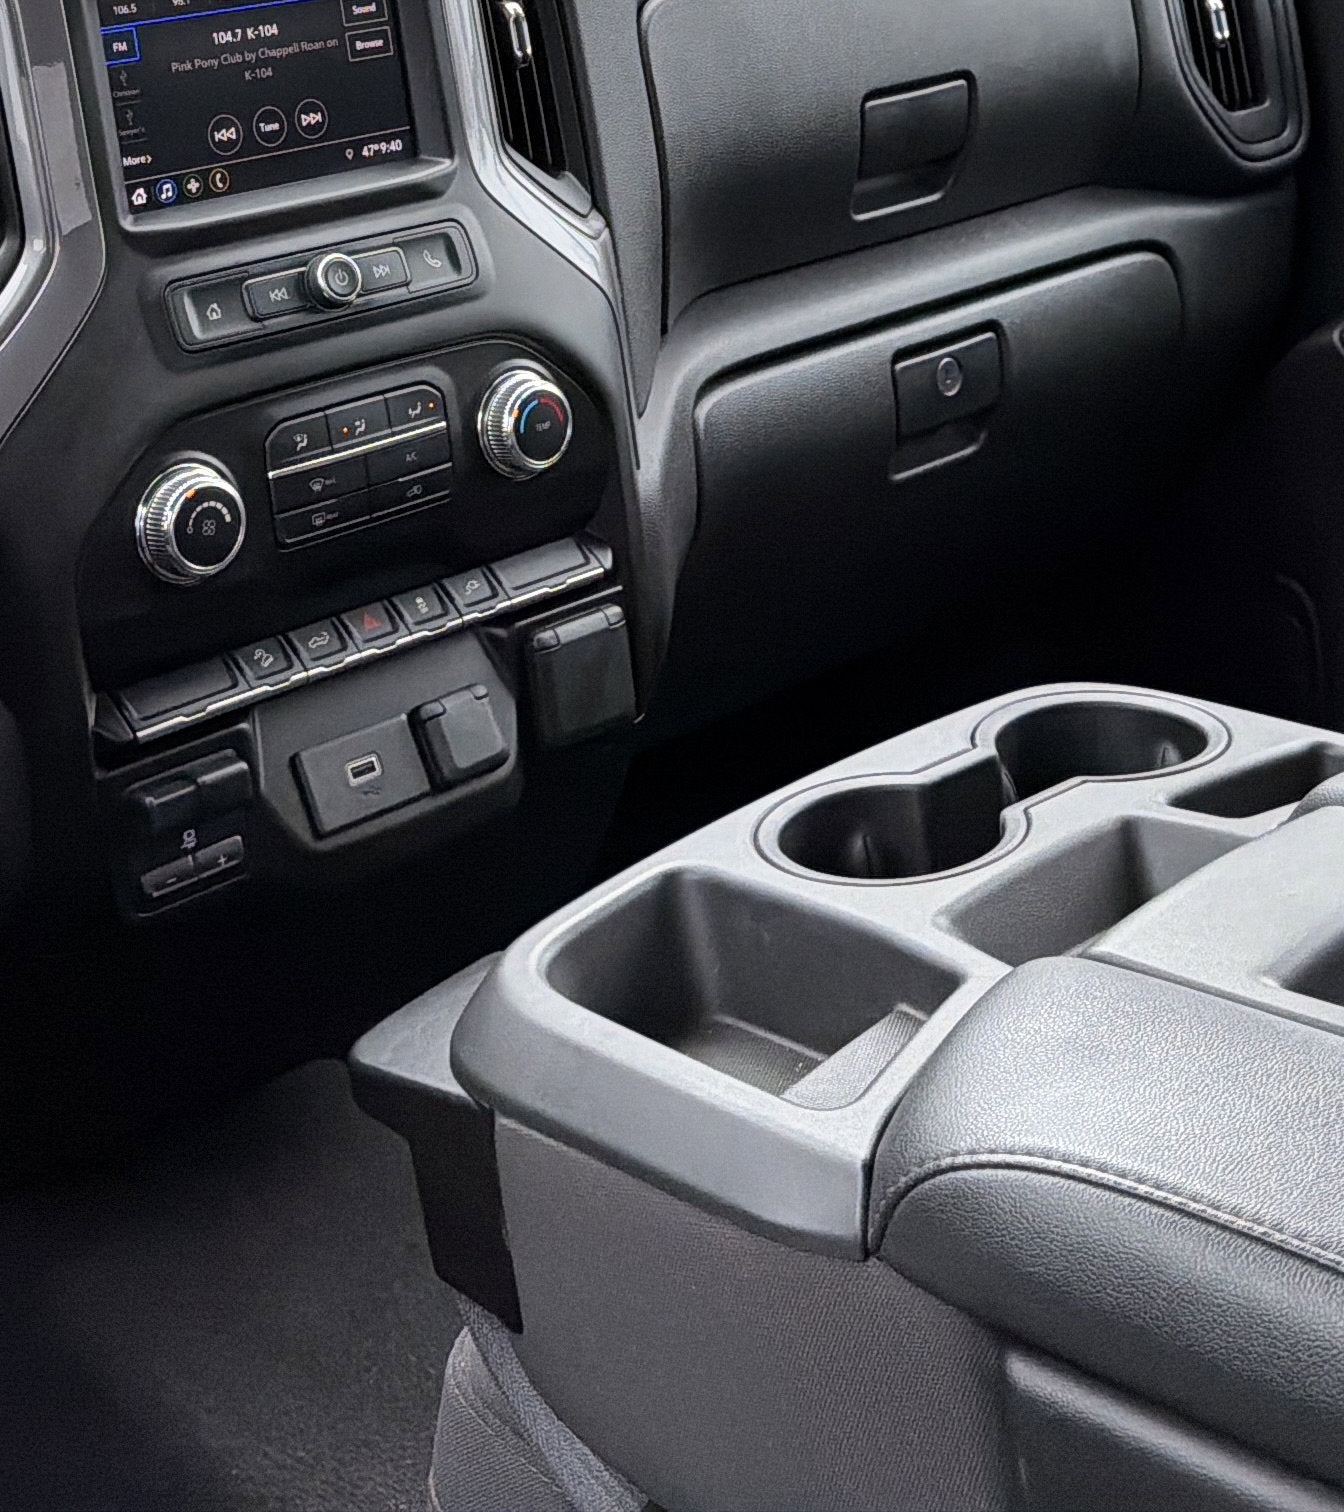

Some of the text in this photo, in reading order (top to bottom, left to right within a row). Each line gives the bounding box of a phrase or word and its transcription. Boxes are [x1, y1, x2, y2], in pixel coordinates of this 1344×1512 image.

[112, 3, 138, 16] 106.5
[351, 2, 377, 16] Sound
[212, 23, 279, 45] 104.7 K-104
[112, 41, 128, 53] FM
[355, 39, 384, 51] Browse
[170, 39, 339, 73] Pink Pony Club by Chappell Roan on
[244, 67, 273, 81] K-104
[258, 121, 280, 133] Tune
[122, 155, 147, 167] More
